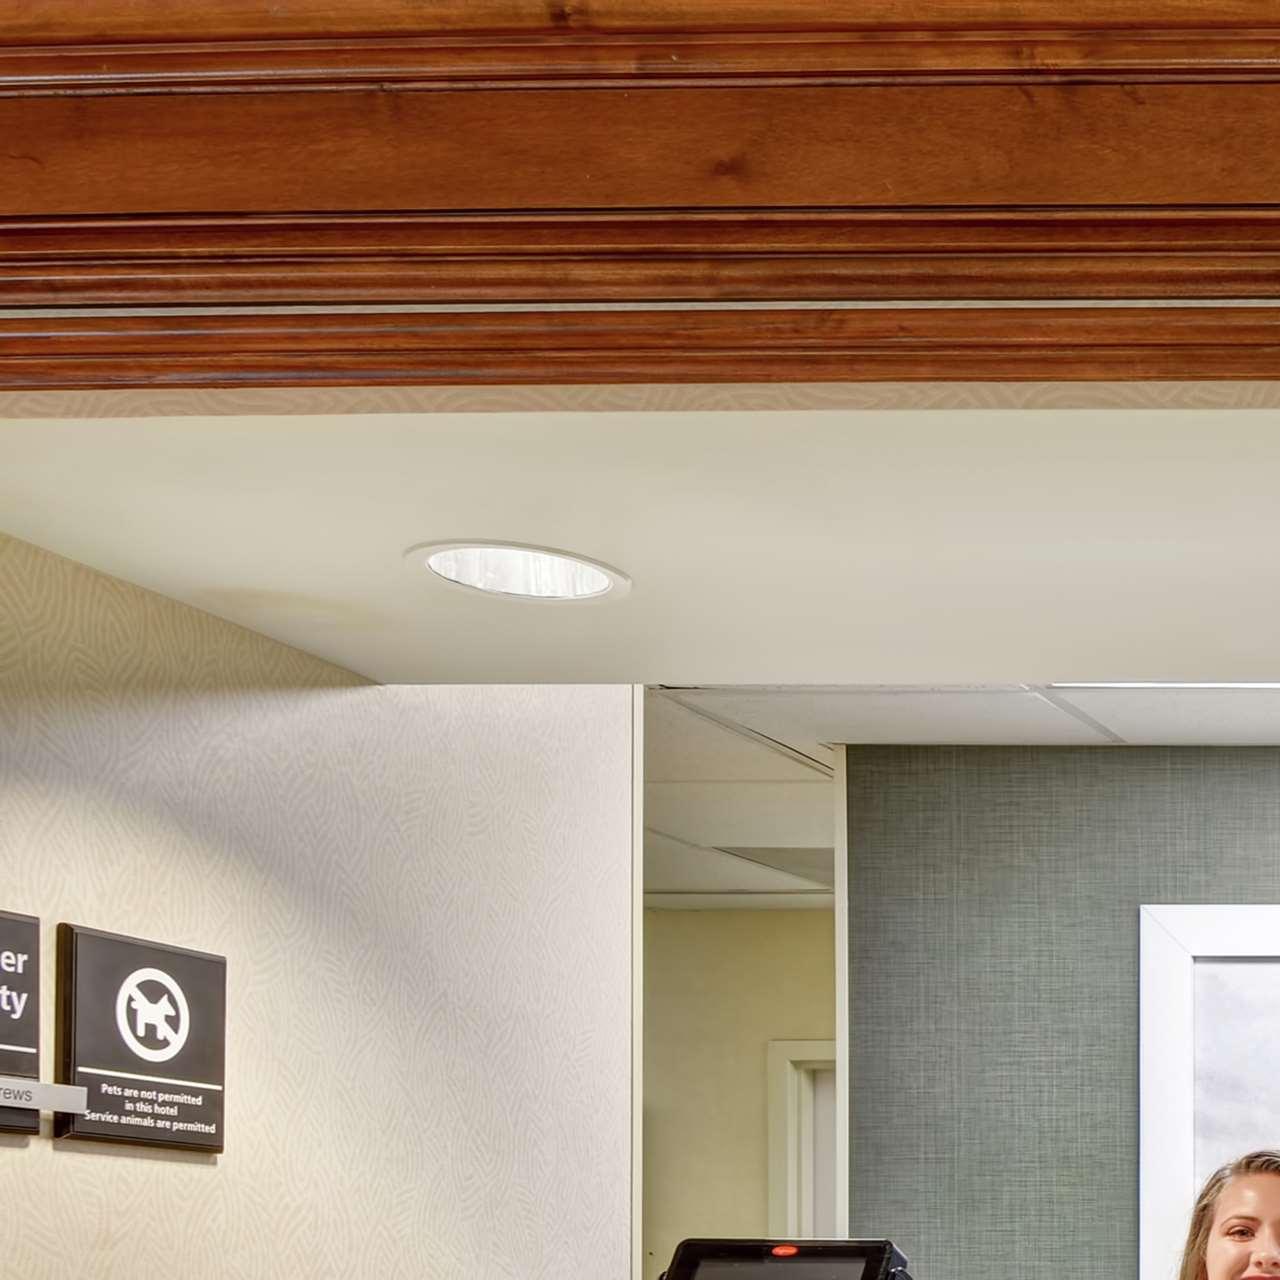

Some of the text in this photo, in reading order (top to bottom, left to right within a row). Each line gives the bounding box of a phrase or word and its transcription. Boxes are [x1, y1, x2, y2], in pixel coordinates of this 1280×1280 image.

[101, 1083, 203, 1106] Pets are not permitted
[124, 1100, 179, 1116] in this hotel
[84, 1109, 216, 1134] Service animals are permitted
